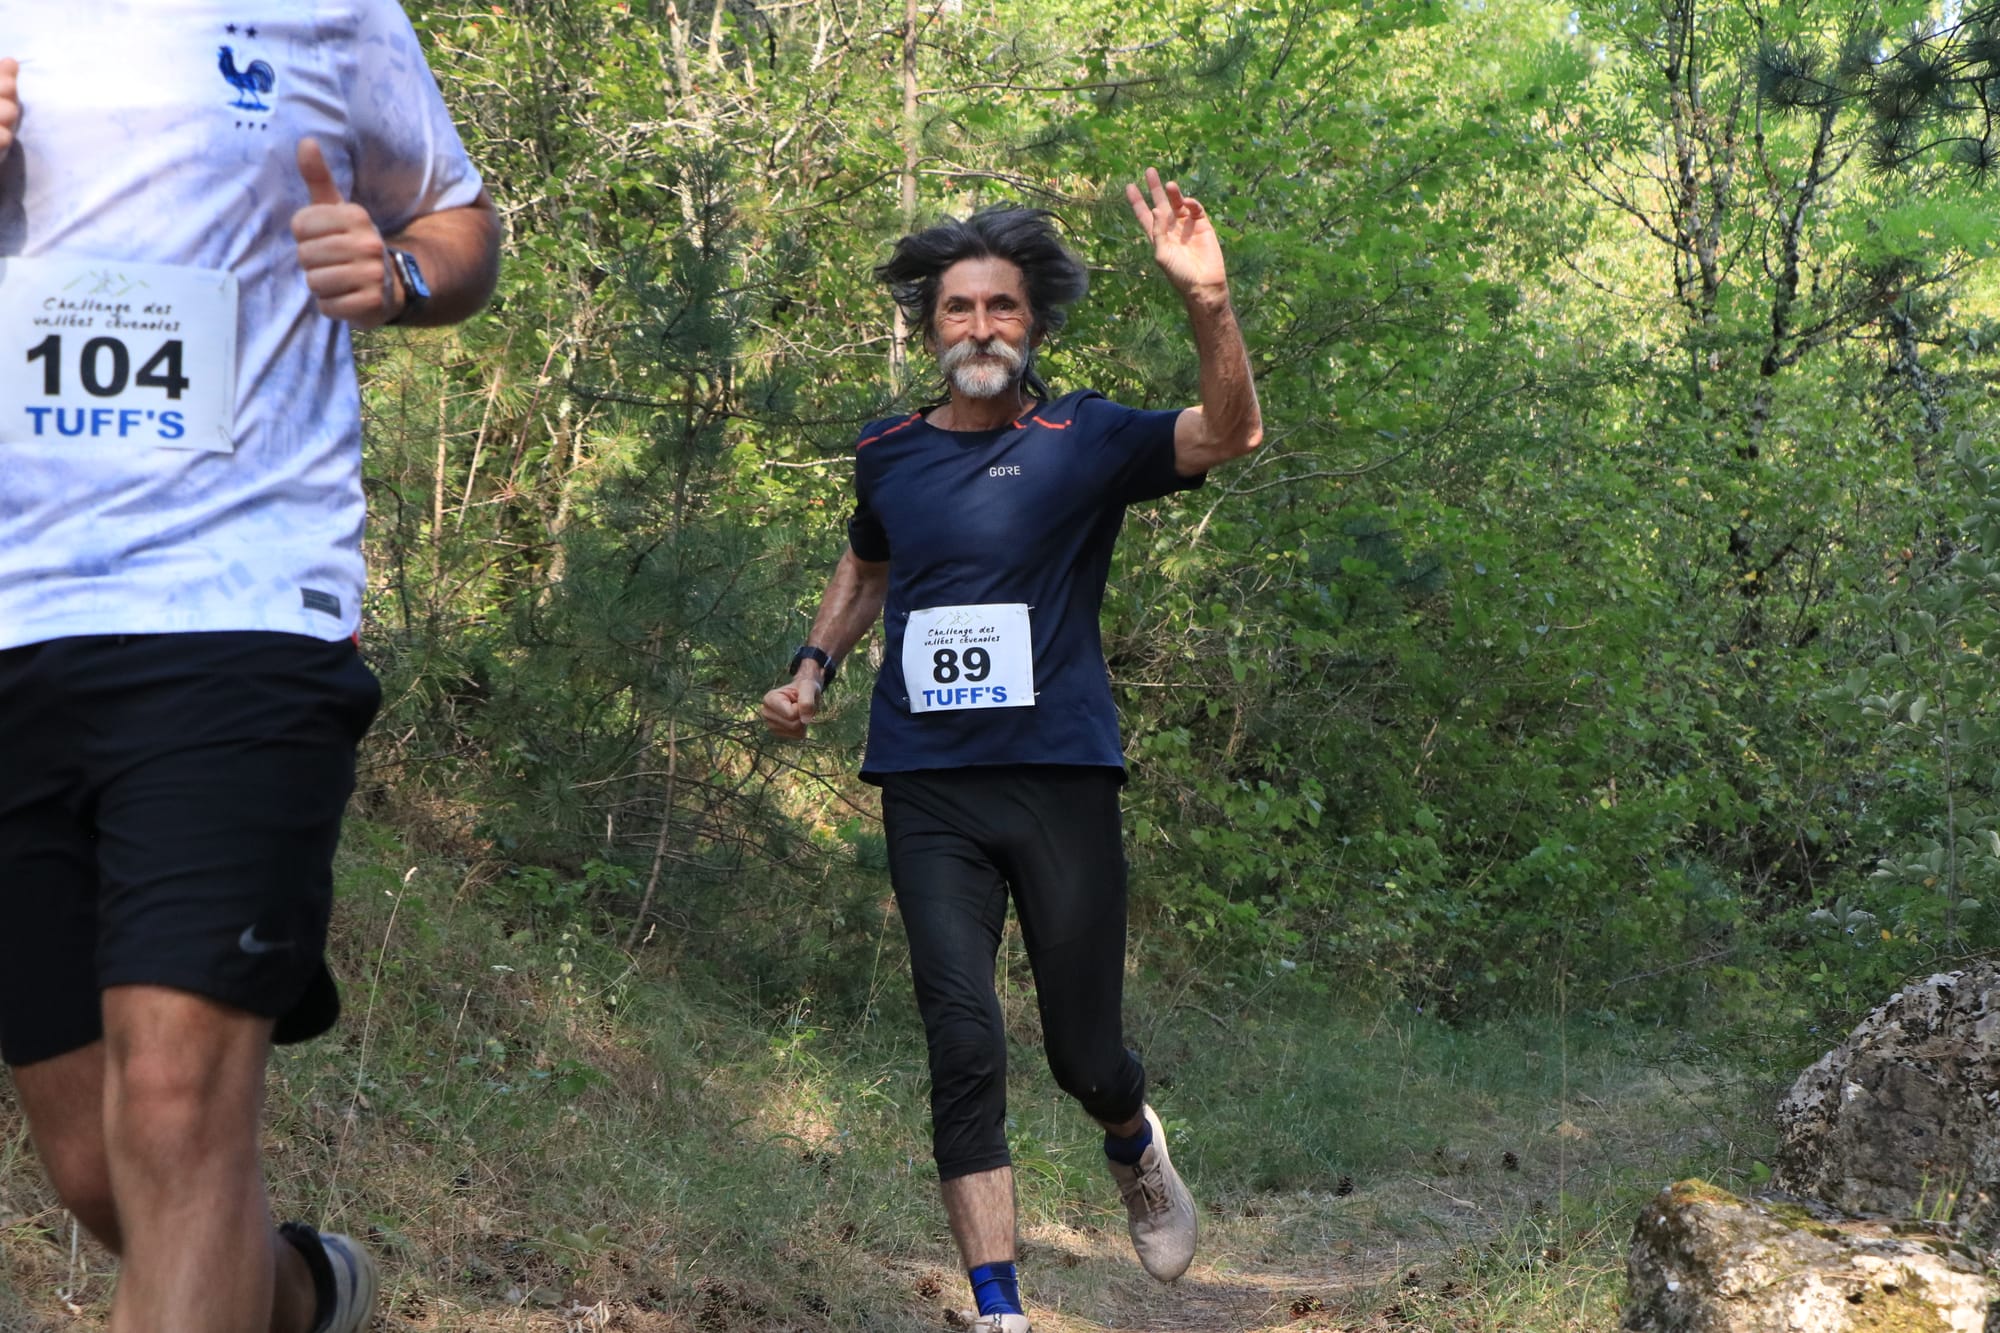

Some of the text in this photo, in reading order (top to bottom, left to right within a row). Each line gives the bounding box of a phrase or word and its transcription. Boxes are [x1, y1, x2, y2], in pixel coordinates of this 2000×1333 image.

[43, 297, 172, 317] Challenge des
[27, 334, 189, 400] 104
[25, 406, 185, 440] TUFF'S
[989, 465, 1021, 477] GORE
[928, 626, 995, 637] Challenge des
[933, 647, 991, 684] 89
[922, 686, 1007, 707] TUFF'S
